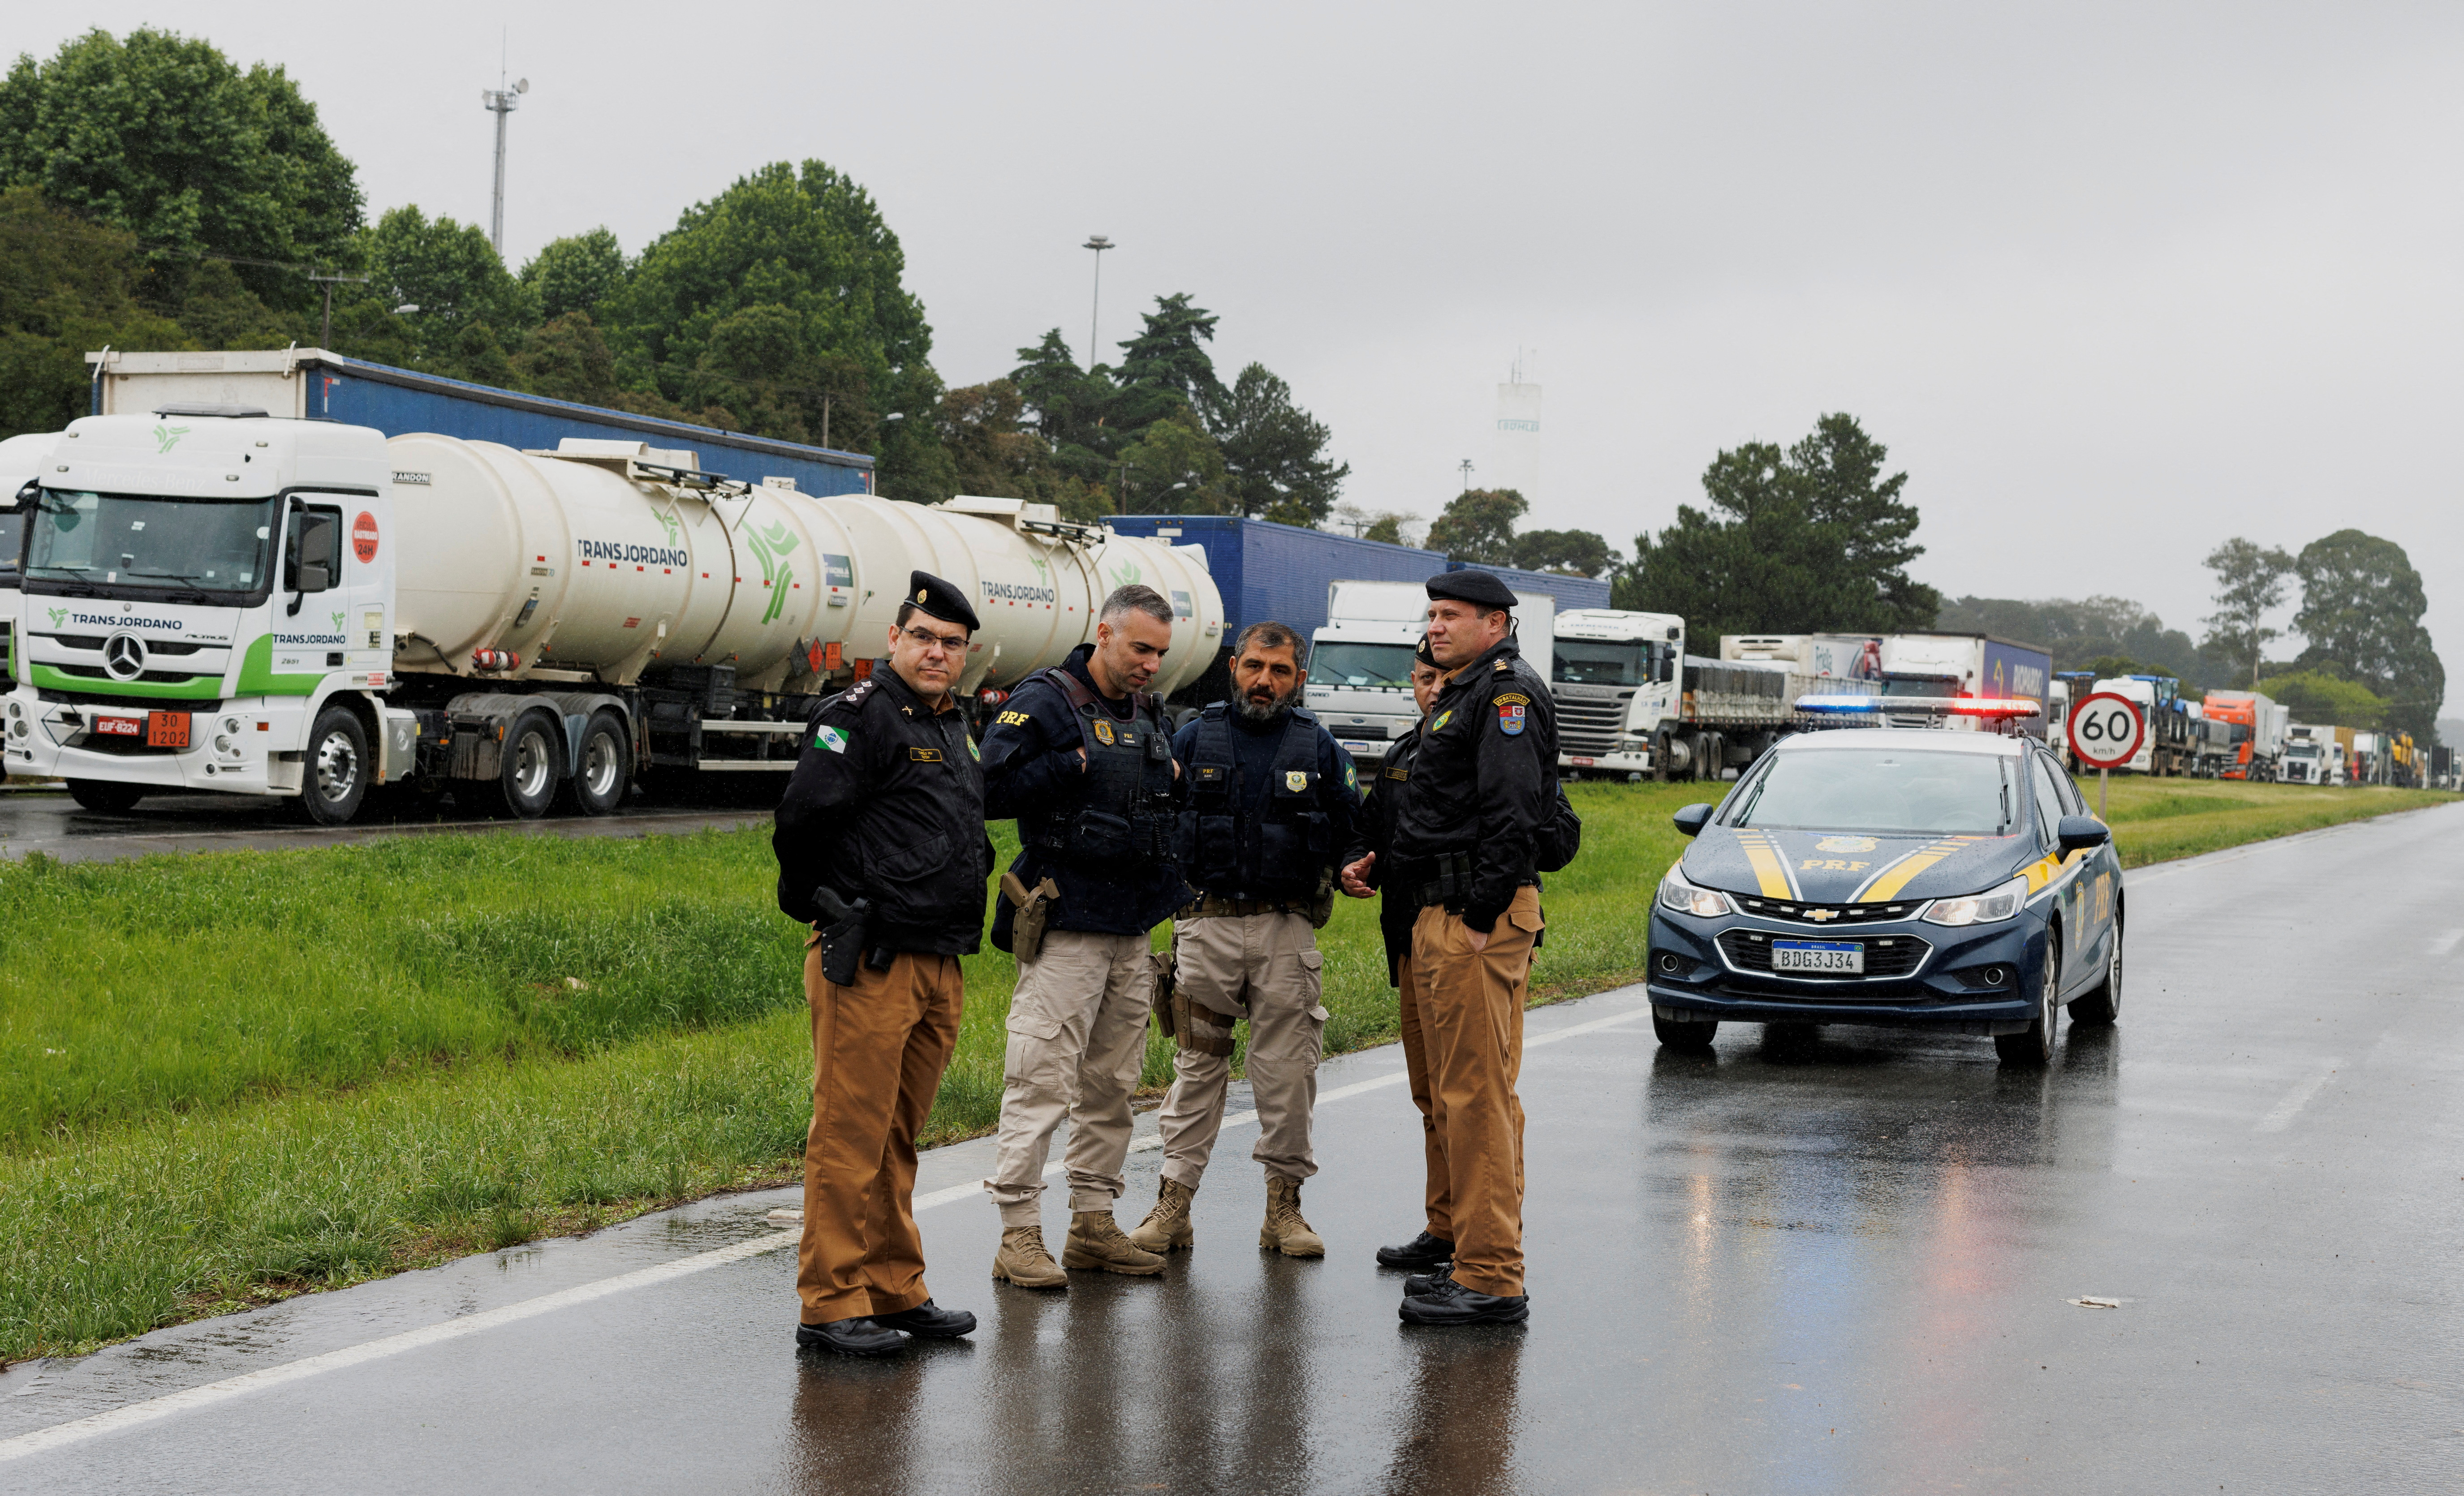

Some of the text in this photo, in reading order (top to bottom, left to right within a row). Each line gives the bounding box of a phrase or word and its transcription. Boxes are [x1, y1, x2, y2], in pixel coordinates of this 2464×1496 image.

[83, 467, 206, 491] Mercedes-Benz
[392, 473, 428, 482] RANDON
[354, 530, 377, 540] RASTREADO
[358, 544, 373, 555] 24H
[578, 540, 687, 567] TRANSJORDANO
[982, 582, 1054, 602] TRANSJORDANO
[72, 614, 182, 630] TRANSJORDANO
[273, 634, 345, 644] TRANSJORDANO
[1565, 687, 1609, 696] SCANIA
[1502, 695, 1526, 704] BATALHÃO
[161, 714, 177, 727] 30
[996, 710, 1029, 726] PRF
[98, 722, 138, 734] EUF-8224
[2083, 710, 2130, 742] 60
[153, 731, 186, 744] 1202
[2093, 747, 2115, 755] km/h
[1800, 860, 1870, 871] PRF
[2094, 871, 2111, 925] PRF
[1782, 950, 1853, 969] BDG3J34
